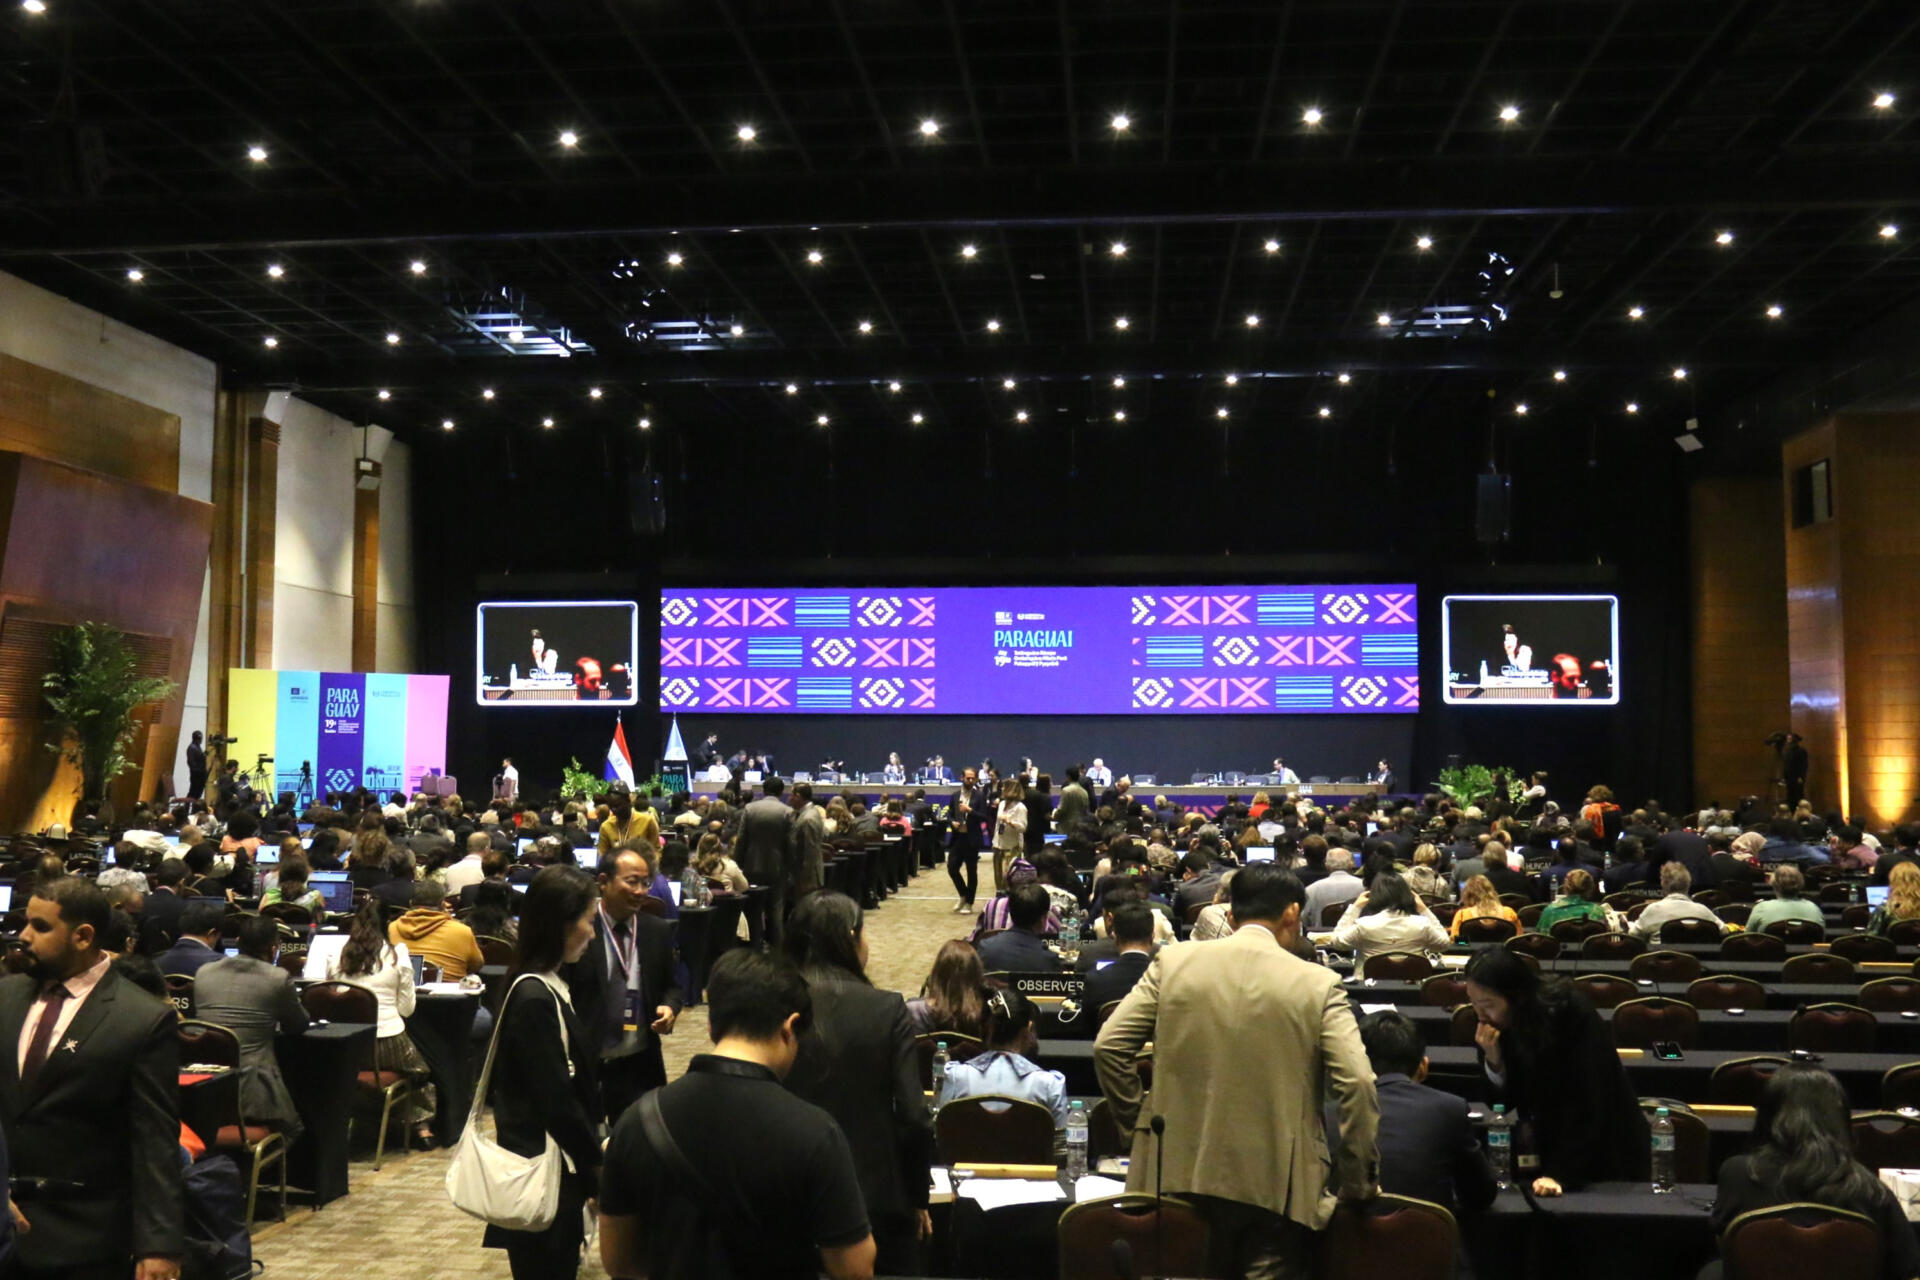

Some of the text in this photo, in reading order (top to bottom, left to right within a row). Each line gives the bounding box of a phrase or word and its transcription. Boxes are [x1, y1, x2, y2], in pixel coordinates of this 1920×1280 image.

[994, 630, 1073, 648] PARAGUAI
[326, 687, 359, 704] PARA
[325, 703, 360, 718] GUAY
[662, 774, 685, 784] PARA
